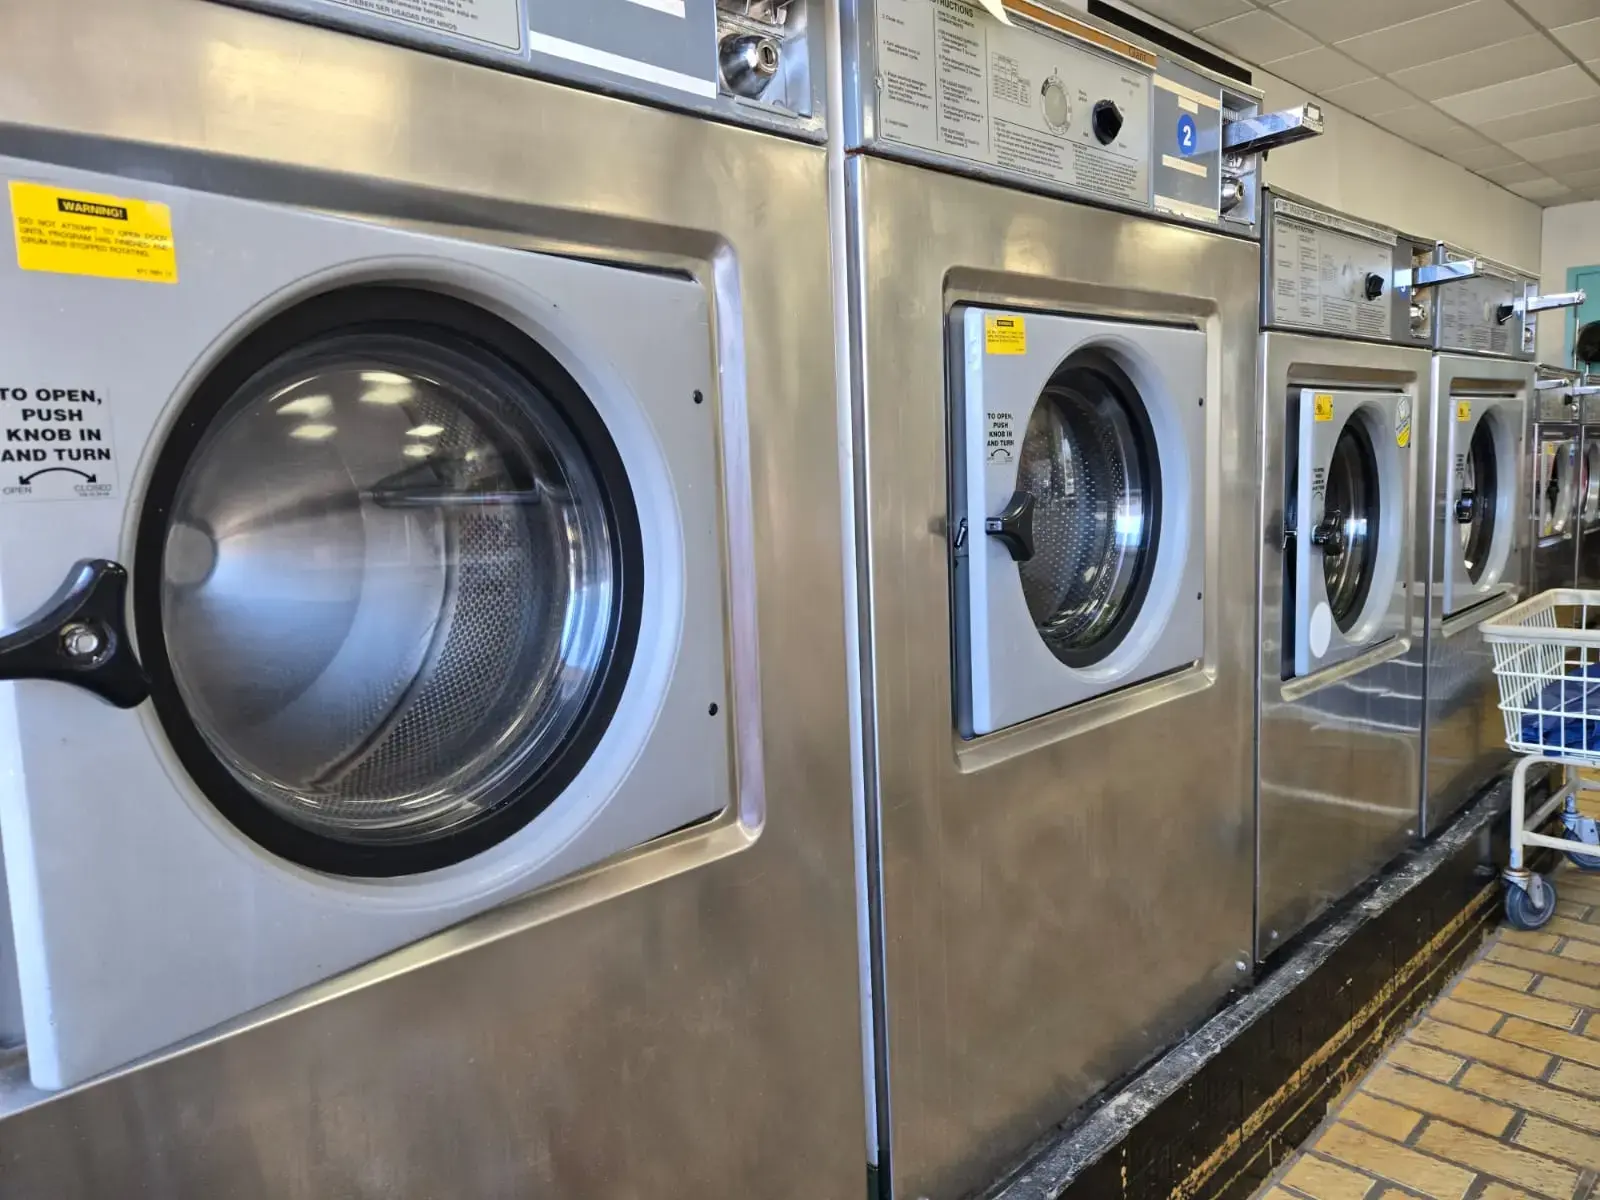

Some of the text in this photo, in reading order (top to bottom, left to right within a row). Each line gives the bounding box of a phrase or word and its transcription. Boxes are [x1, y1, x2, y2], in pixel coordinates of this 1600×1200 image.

[375, 4, 391, 14] SER
[392, 8, 420, 21] USADAS
[421, 16, 436, 24] POR
[932, 0, 974, 18] TRUCTIONS
[1182, 126, 1192, 147] 2
[62, 200, 124, 218] WARNING!
[38, 218, 56, 228] NOT
[61, 222, 98, 232] ATTEMPT
[103, 226, 115, 236] TO
[118, 228, 141, 239] OPEN
[144, 233, 168, 242] DOOR
[48, 230, 92, 242] PROGRAM
[20, 236, 48, 246] DRUM
[50, 239, 67, 248] HAS
[70, 240, 108, 253] STOPPED
[0, 387, 102, 406] TO OPEN,
[22, 408, 84, 422] PUSH
[6, 428, 102, 442] KNOB IN
[0, 448, 112, 462] AND TURN
[2, 483, 112, 496] OPEN CLOSED
